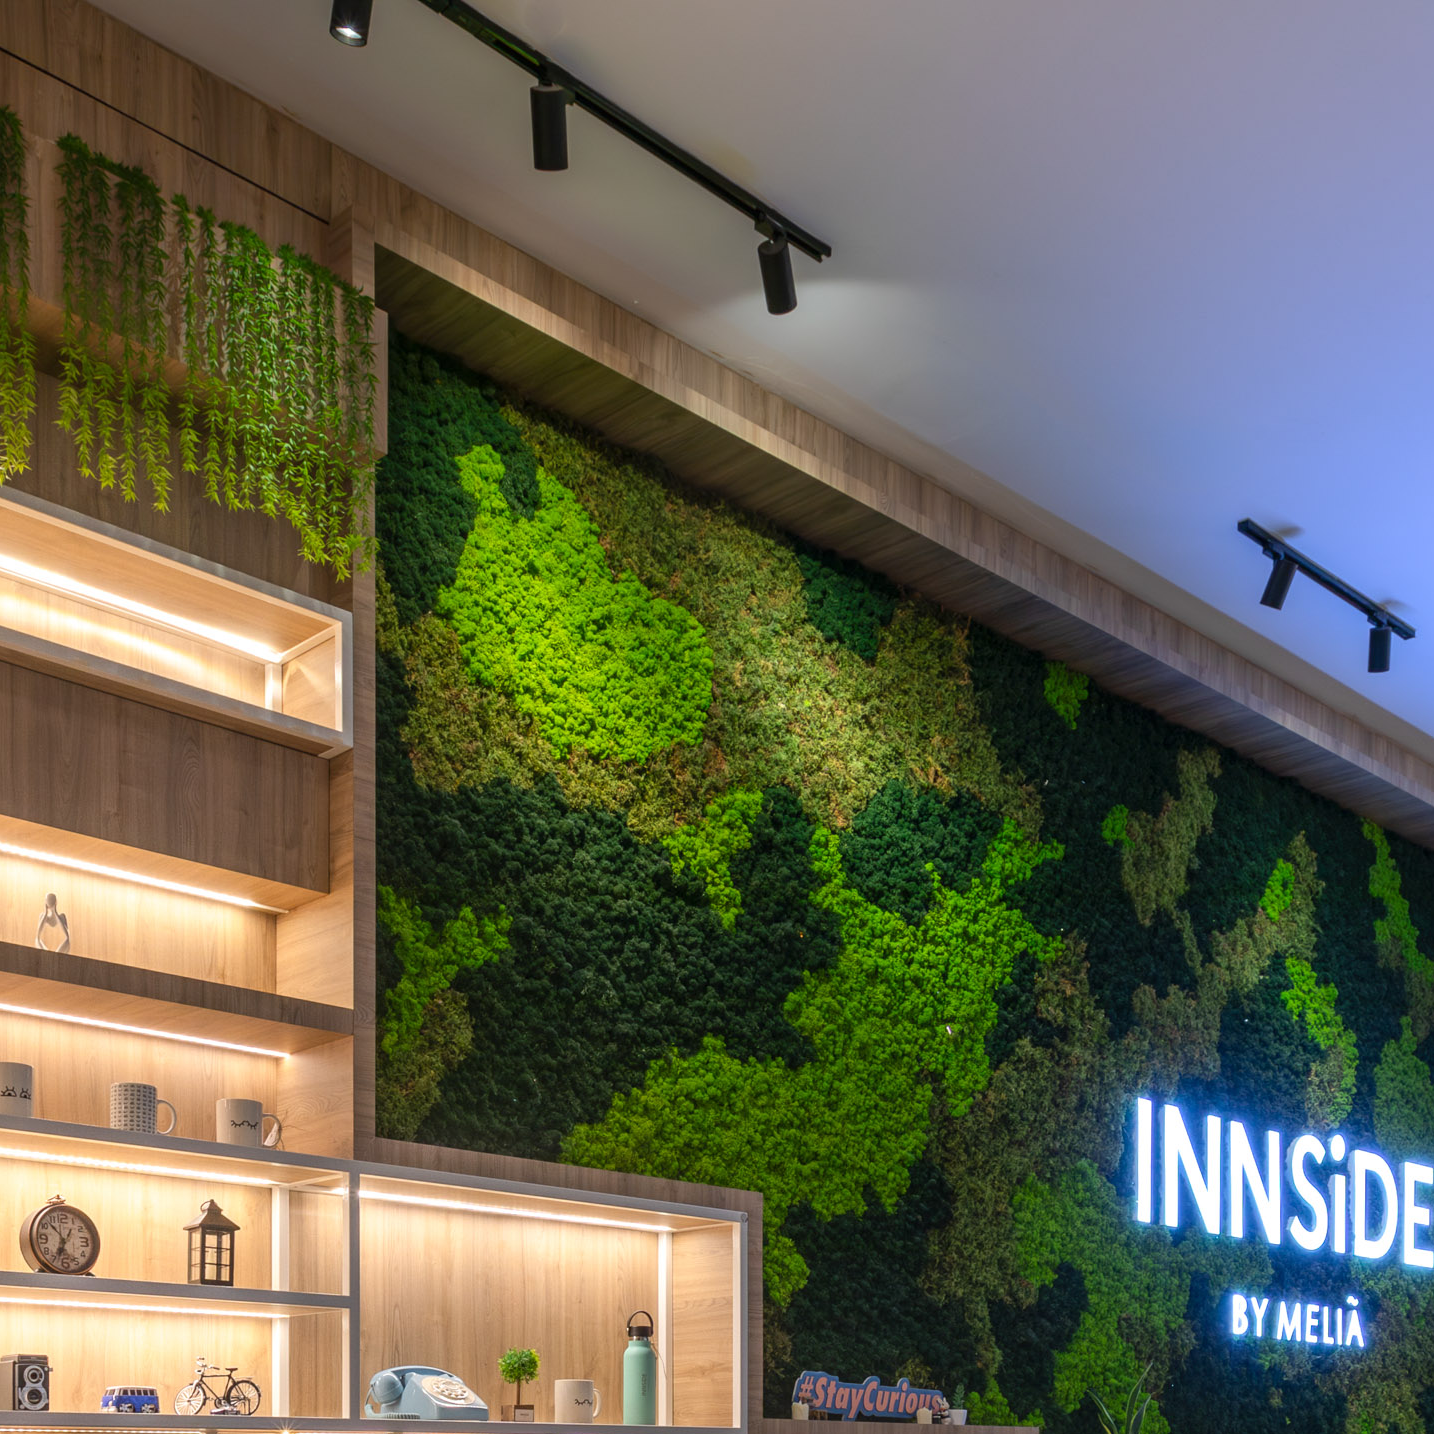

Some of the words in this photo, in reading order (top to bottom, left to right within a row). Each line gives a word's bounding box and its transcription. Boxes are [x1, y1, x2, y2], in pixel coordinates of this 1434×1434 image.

[57, 1213, 69, 1224] 12
[41, 1222, 49, 1230] 10
[39, 1234, 49, 1244] 9
[79, 1236, 89, 1248] 3
[44, 1247, 49, 1255] 8
[61, 1257, 71, 1269] 6
[1232, 1294, 1270, 1338] BY
[798, 1376, 941, 1419] #StayCurious
